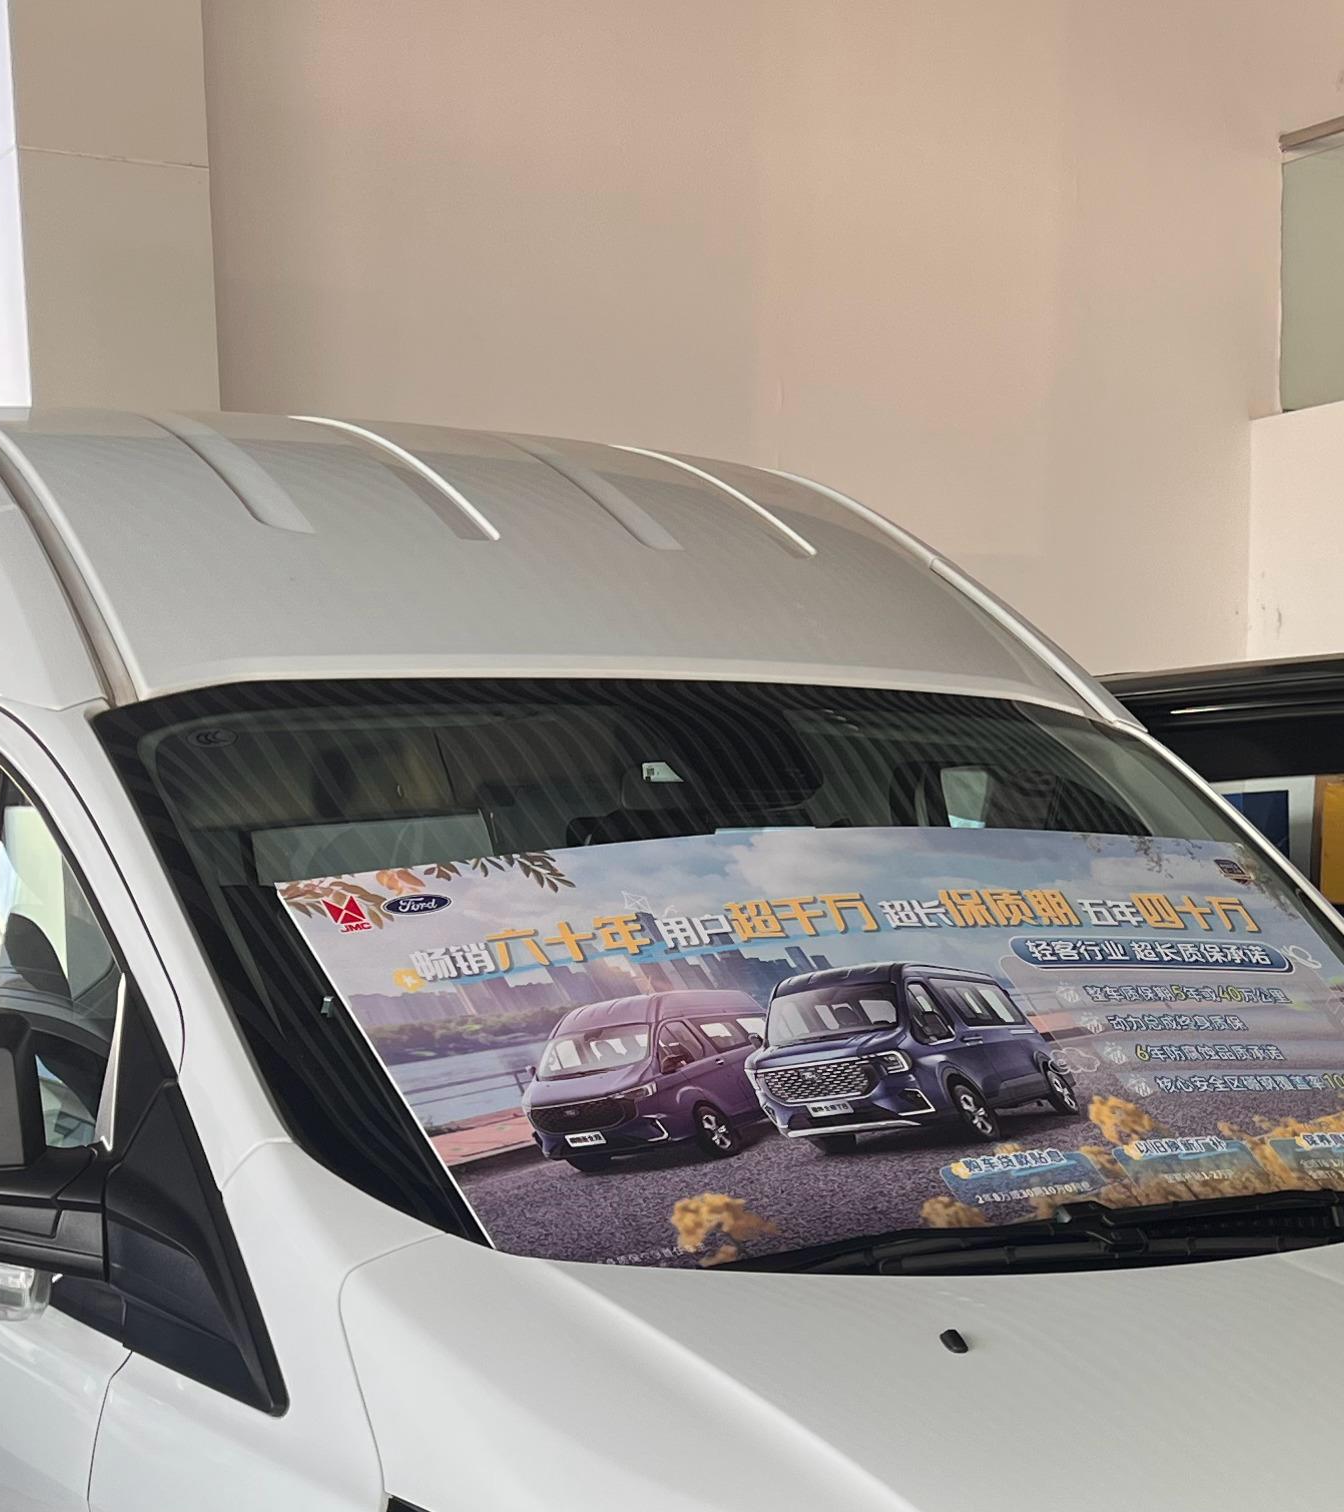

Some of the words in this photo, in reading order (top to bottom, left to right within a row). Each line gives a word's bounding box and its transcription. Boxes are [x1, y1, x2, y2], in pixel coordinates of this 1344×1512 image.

[398, 897, 438, 912] Ford
[341, 922, 372, 933] JMC
[409, 913, 652, 981] 畅销六十年
[655, 892, 879, 948] 用户超千万
[878, 888, 1082, 928] 超长保质期
[1078, 891, 1262, 933] 五年四十万
[1025, 939, 1130, 963] 轻客行业
[1130, 941, 1273, 965] 超长质保承诺
[1107, 1014, 1249, 1032] 动力总成终身质保
[1135, 1044, 1287, 1063] 6年防腐蚀品质承诺
[963, 1150, 1066, 1173] 购车贷款贴息
